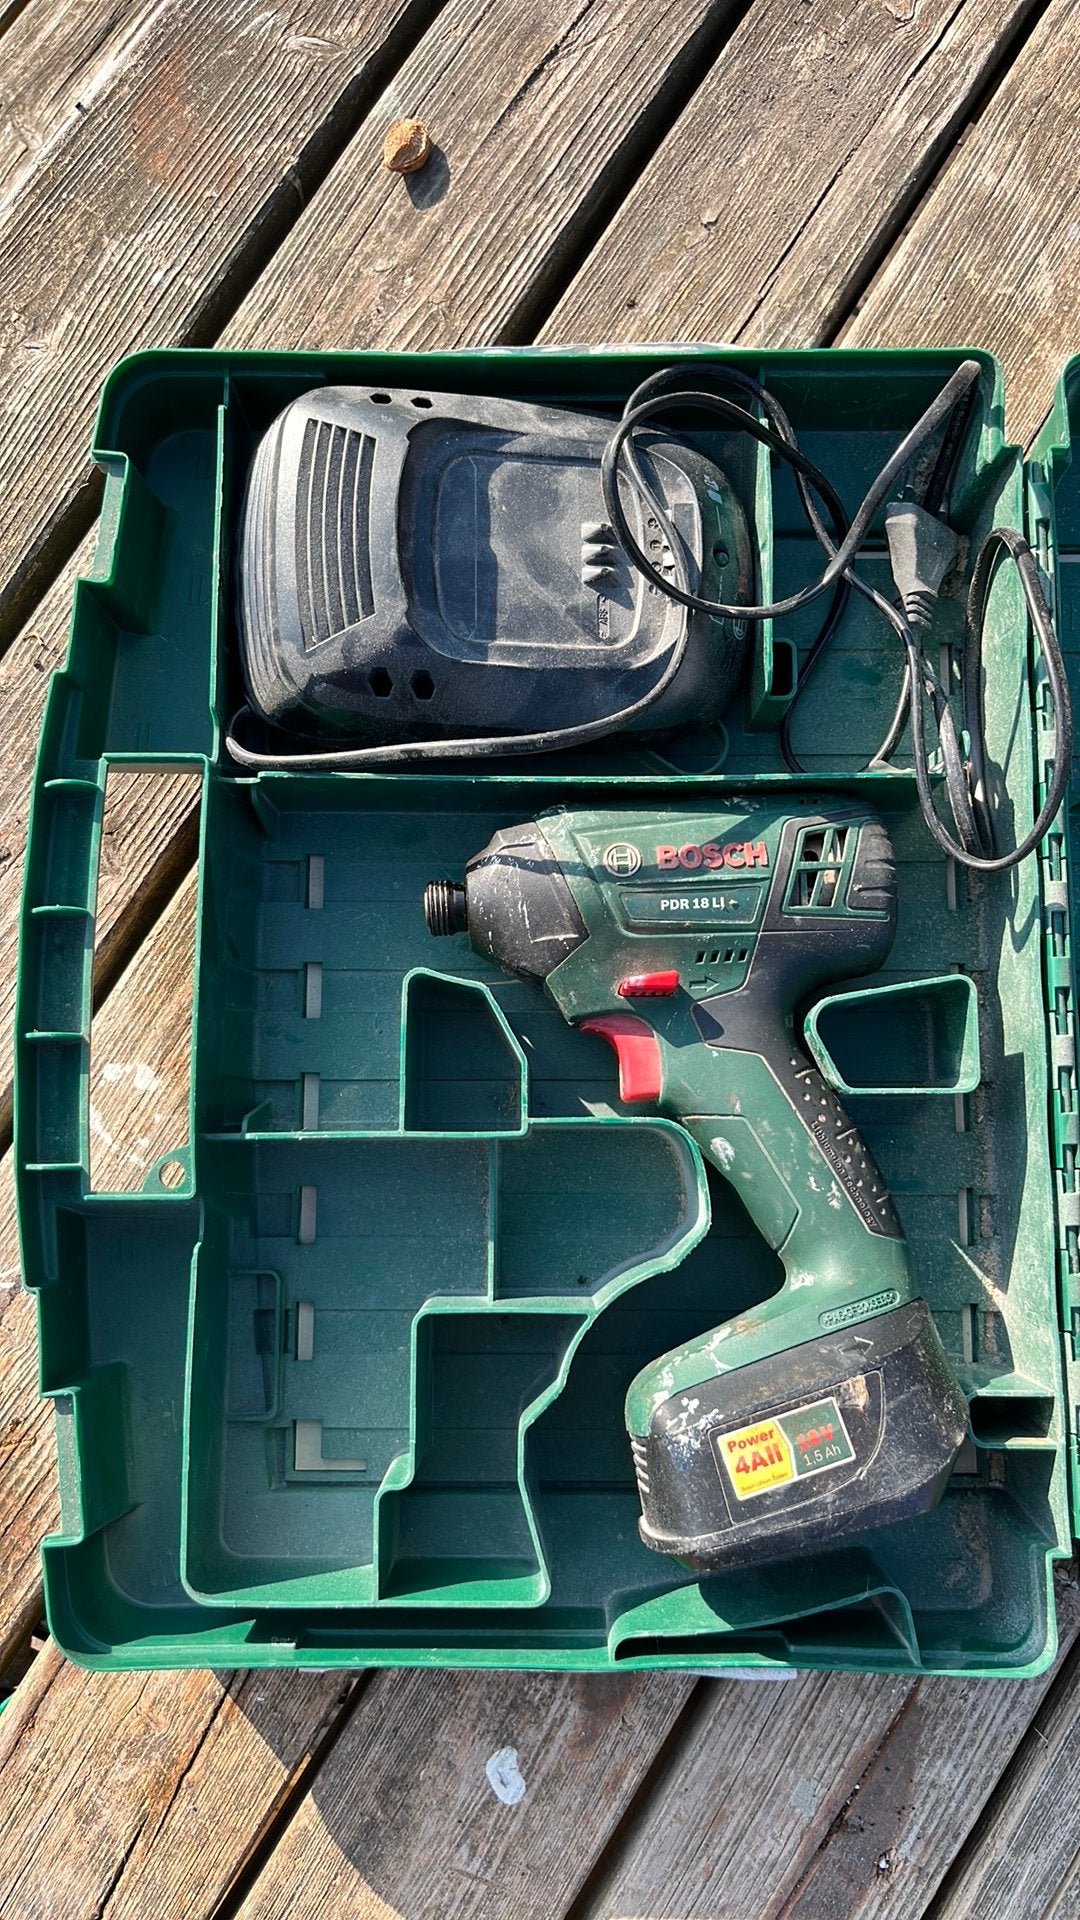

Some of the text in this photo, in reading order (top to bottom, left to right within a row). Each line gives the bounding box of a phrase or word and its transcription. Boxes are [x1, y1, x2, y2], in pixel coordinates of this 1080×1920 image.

[655, 841, 769, 870] BOSCH
[660, 898, 690, 911] PDR
[692, 897, 710, 909] 18
[843, 1174, 878, 1228] Technology
[727, 1428, 774, 1453] Power
[825, 1444, 842, 1459] Ah
[735, 1443, 784, 1475] 4All
